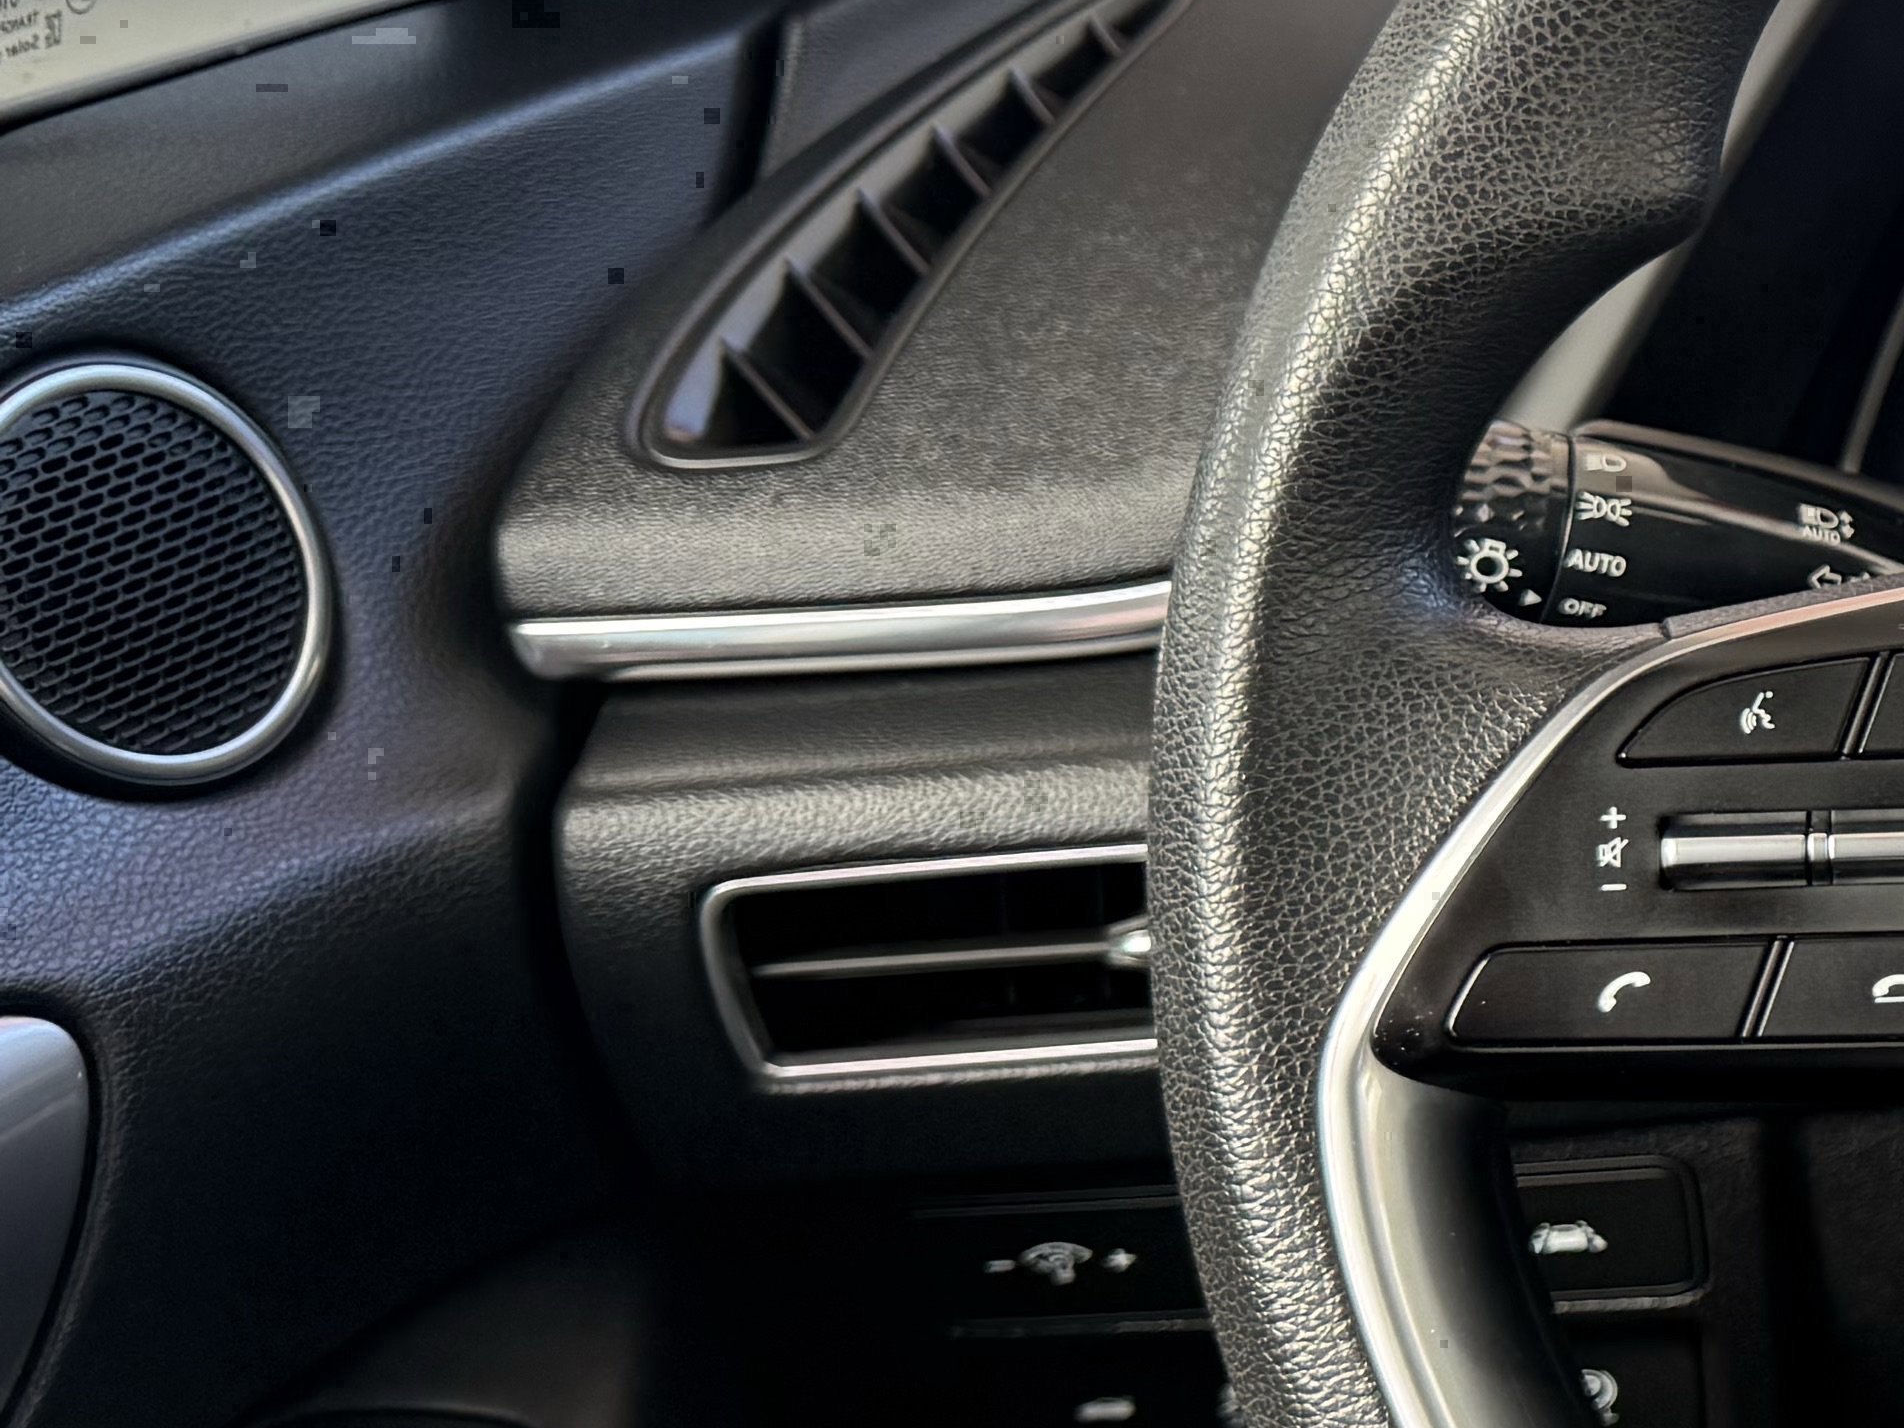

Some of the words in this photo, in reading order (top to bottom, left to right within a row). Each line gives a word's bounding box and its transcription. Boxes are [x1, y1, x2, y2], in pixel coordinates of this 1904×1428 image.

[1802, 527, 1841, 546] AUTO
[1564, 548, 1627, 578] AUTO
[1558, 597, 1607, 619] OFF
